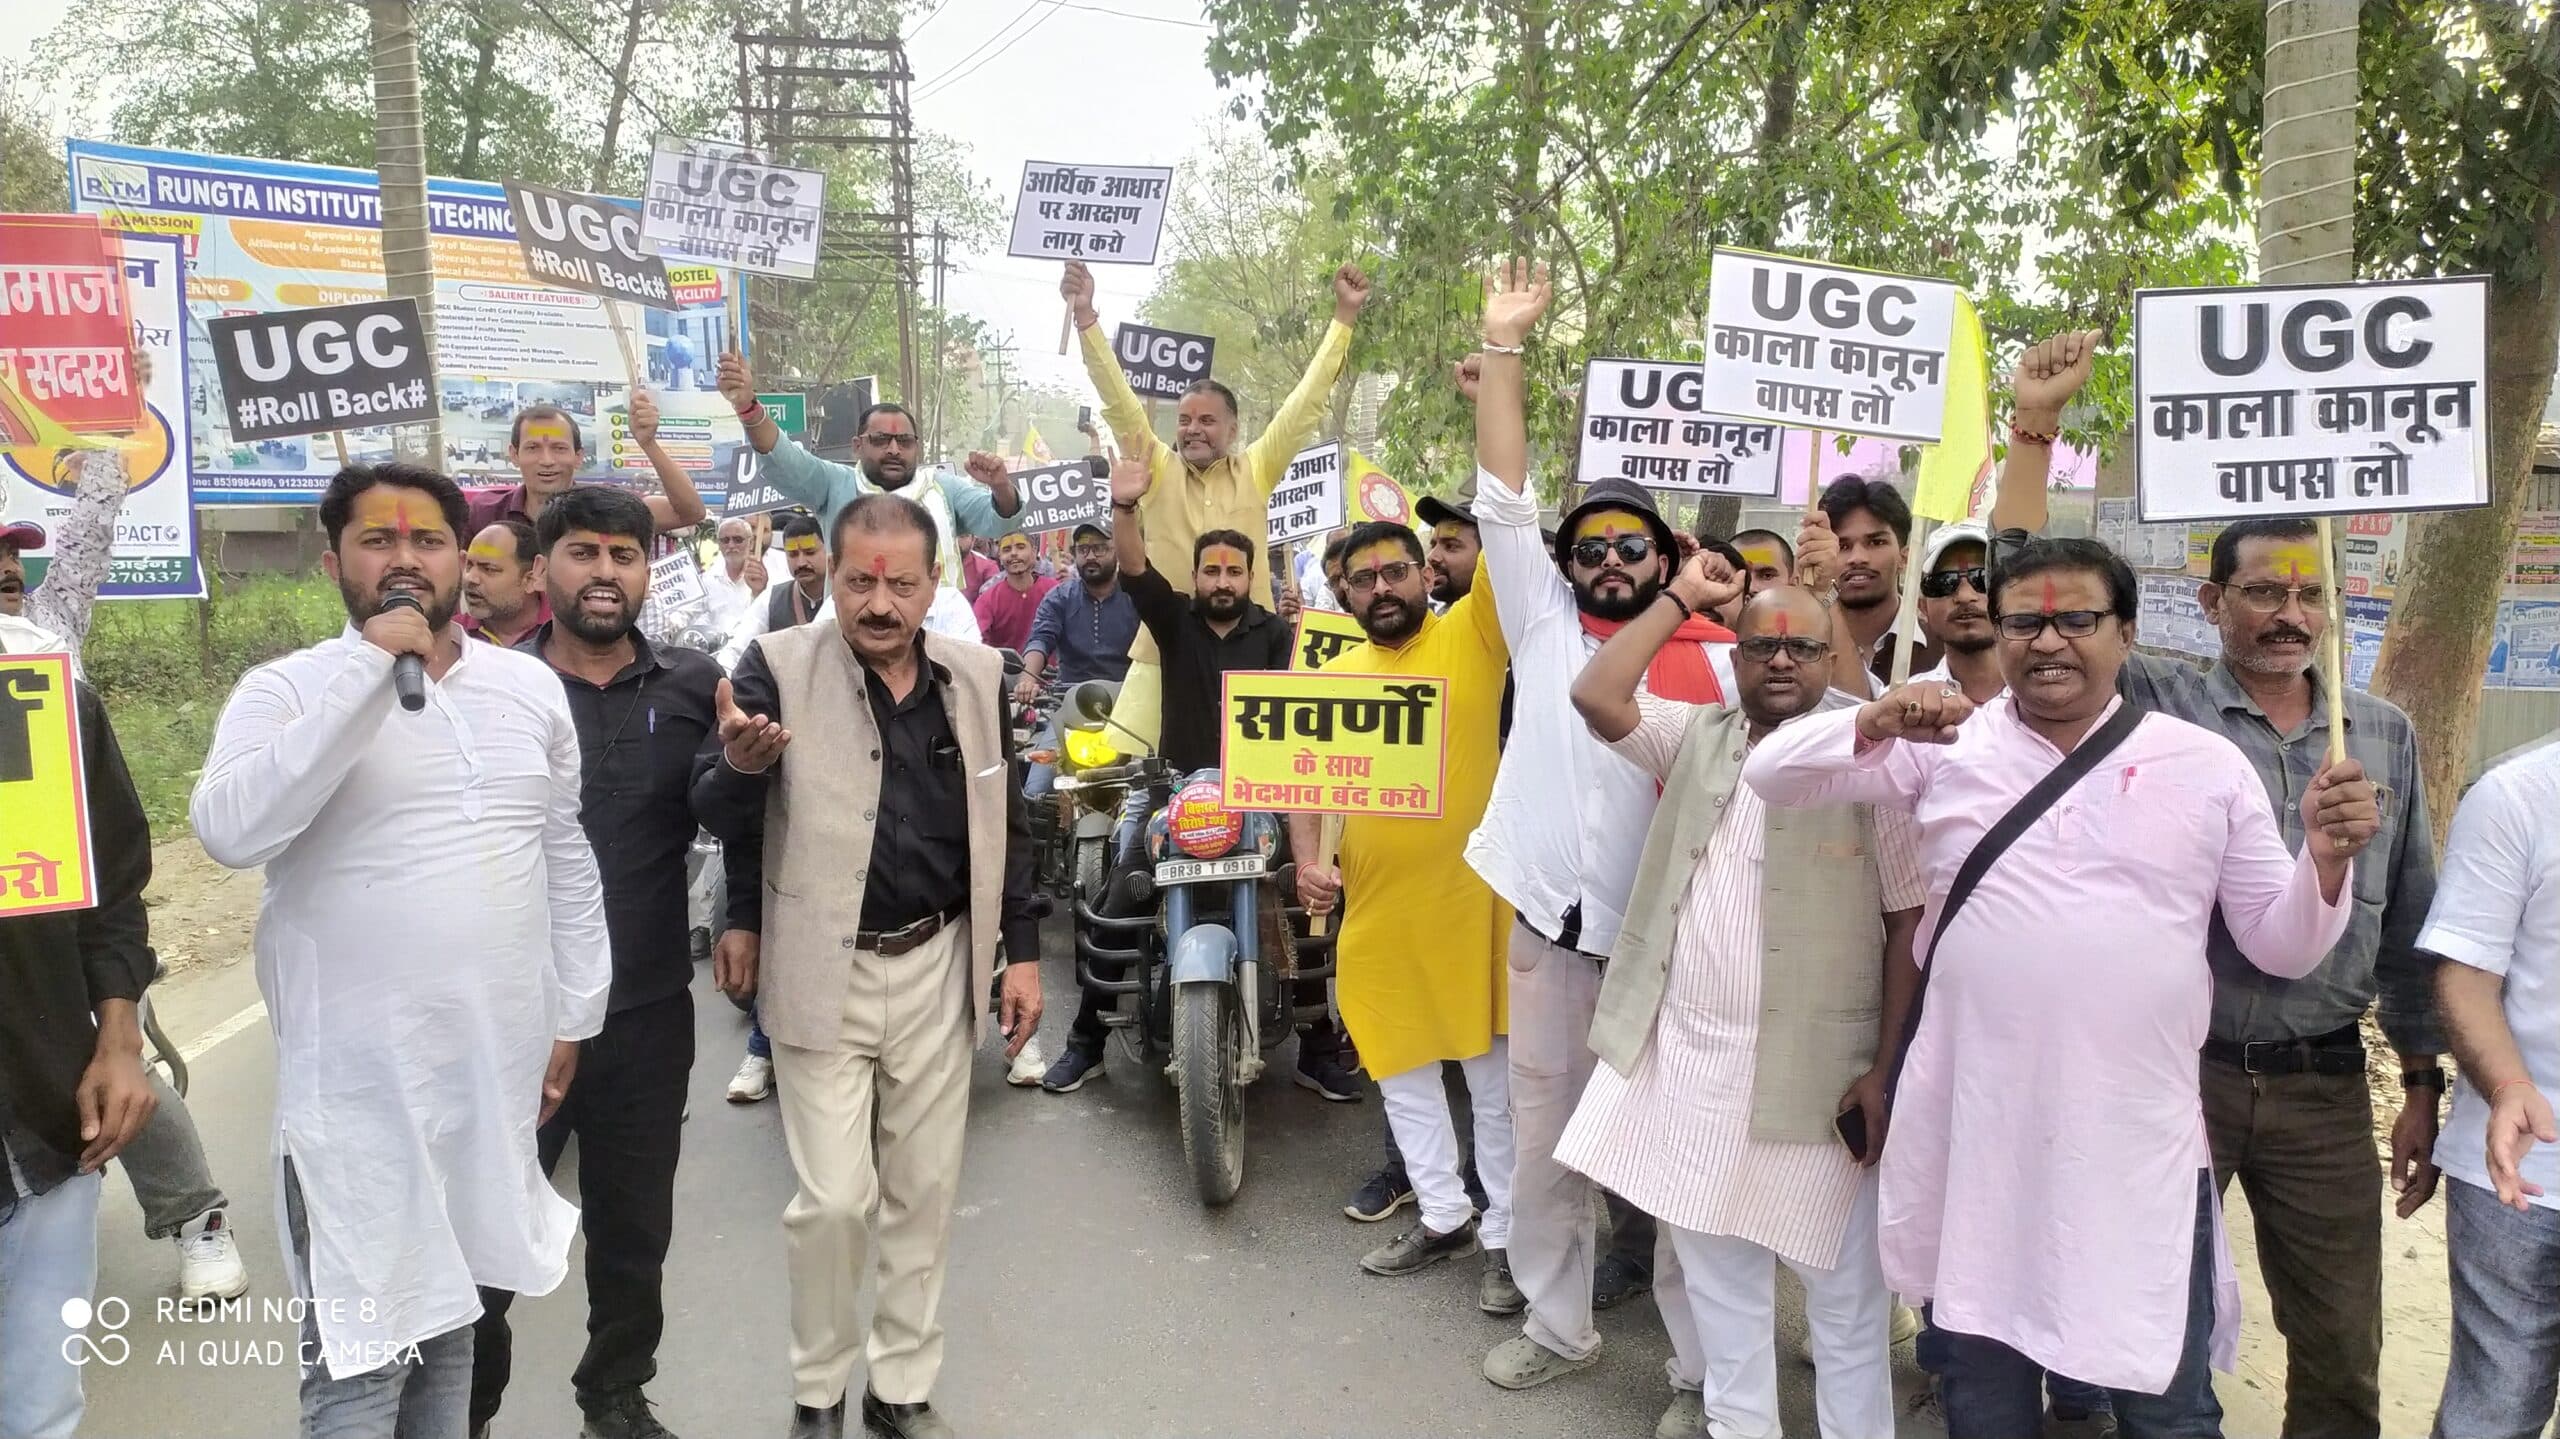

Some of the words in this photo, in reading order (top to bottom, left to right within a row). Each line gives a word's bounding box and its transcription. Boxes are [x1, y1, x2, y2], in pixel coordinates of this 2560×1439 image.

[677, 158, 799, 208] UGC
[1025, 168, 1098, 195] आर्थिक
[1101, 176, 1165, 199] आधार
[156, 175, 260, 211] RUNGTA
[430, 201, 517, 239] TECHNO
[648, 198, 725, 229] काला
[733, 210, 815, 246] कानून
[1039, 201, 1064, 220] पर
[1066, 203, 1141, 224] आरक्षण
[679, 235, 742, 262] वापस
[747, 241, 780, 267] लो
[1043, 230, 1084, 256] लागू
[1089, 229, 1125, 253] करो
[530, 246, 593, 284] #Roll
[595, 261, 668, 300] Back#
[674, 287, 716, 301] ACILITY
[1751, 267, 1917, 337] UGC
[233, 314, 409, 382] UGC
[1122, 331, 1205, 372] UGC
[2196, 296, 2433, 376] UGC
[21, 347, 128, 400] सदस्य
[1713, 323, 1820, 370] काला
[1830, 338, 1946, 393] कानून
[1122, 368, 1152, 389] Roll
[1155, 374, 1191, 394] Bac
[1619, 367, 1703, 412] UG
[237, 391, 320, 428] #Roll
[327, 378, 427, 417] Back#
[1756, 378, 1843, 418] वापस
[1851, 384, 1895, 425] लो
[2149, 388, 2296, 442] काला
[2310, 380, 2477, 447] कानून
[1588, 414, 1674, 445] काला
[1682, 418, 1777, 458] कानून
[1290, 452, 1336, 481] आधार
[1621, 454, 1688, 484] वापस
[1698, 453, 1734, 485] लो
[2213, 457, 2337, 503] वापस
[2345, 441, 2413, 498] लो
[728, 487, 759, 511] #Roll
[1268, 480, 1325, 510] आरक्षण
[1022, 509, 1045, 528] oll
[1047, 501, 1095, 523] Back#
[1290, 505, 1319, 529] करो
[116, 525, 162, 542] PACT
[106, 571, 183, 583] 270337
[2176, 586, 2198, 598] BIOLO
[1293, 747, 1317, 775] के
[1325, 755, 1373, 778] साथ
[1234, 776, 1323, 805] भेदभाव
[1331, 781, 1371, 807] बंद
[1379, 783, 1430, 809] करो
[0, 851, 62, 899] रो
[1170, 863, 1202, 878] BR38
[1208, 862, 1216, 874] T
